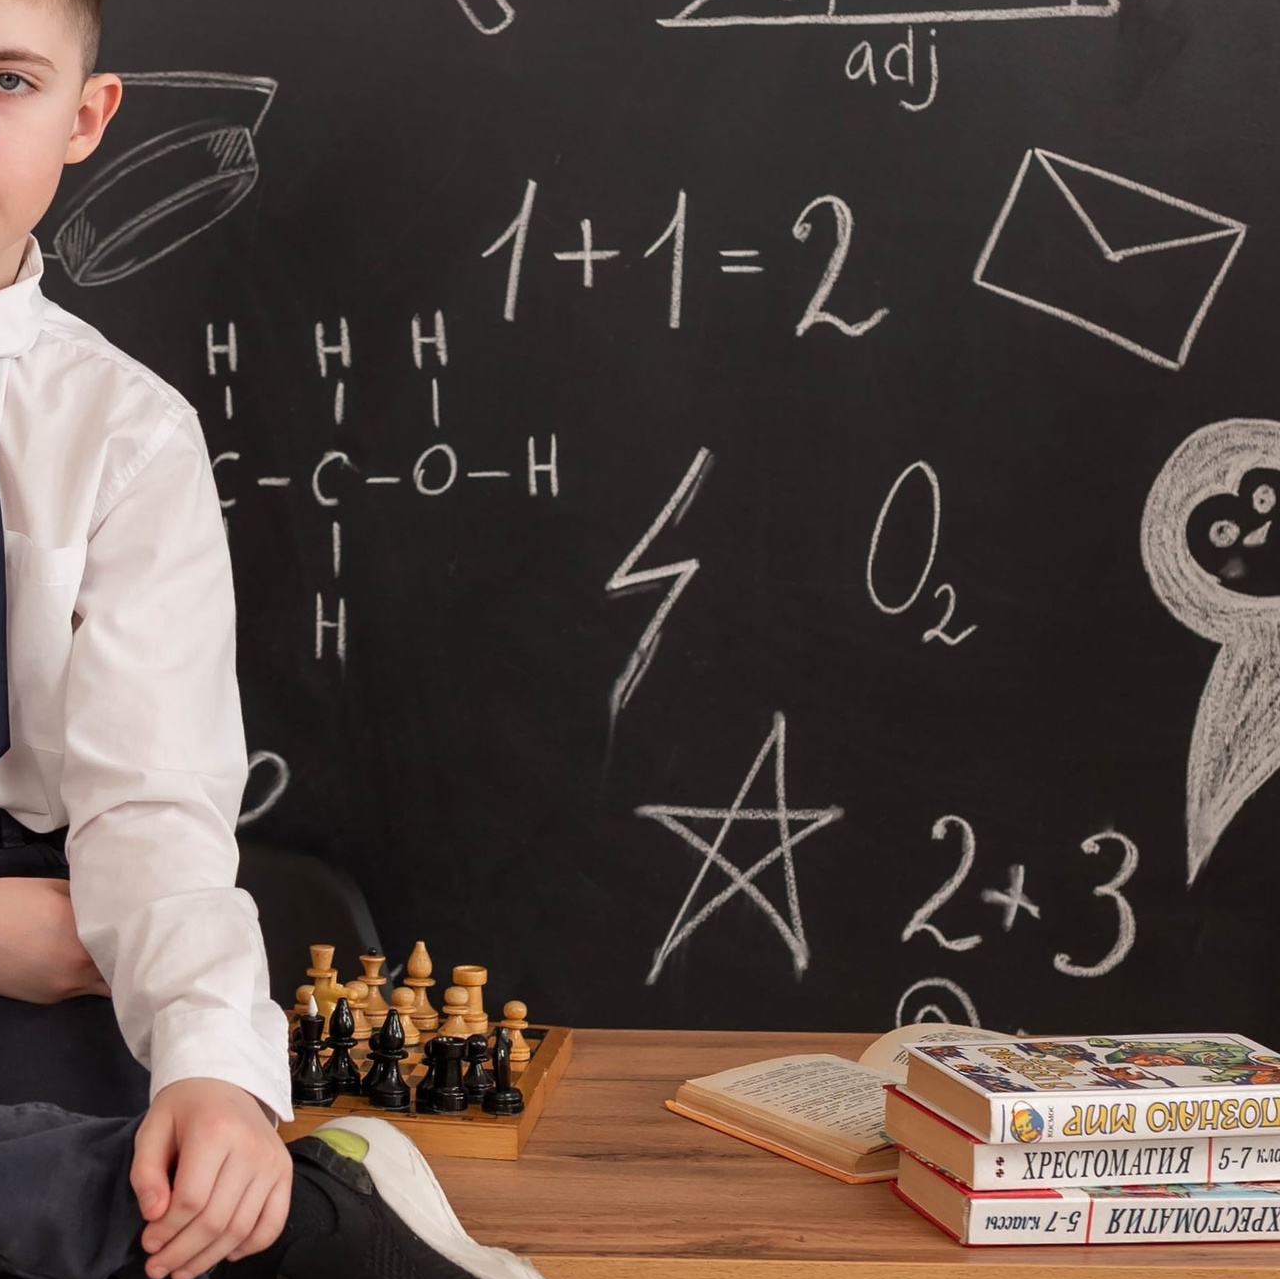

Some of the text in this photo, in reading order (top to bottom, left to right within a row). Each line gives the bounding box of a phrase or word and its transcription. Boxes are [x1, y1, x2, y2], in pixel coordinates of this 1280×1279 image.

[845, 26, 938, 111] adj
[1062, 1103, 1138, 1138] МИР
[1021, 1146, 1194, 1181] ХРЕСТОМАТИЯ
[1218, 1146, 1253, 1171] 5-7
[985, 1211, 1082, 1233] 5-7 классы
